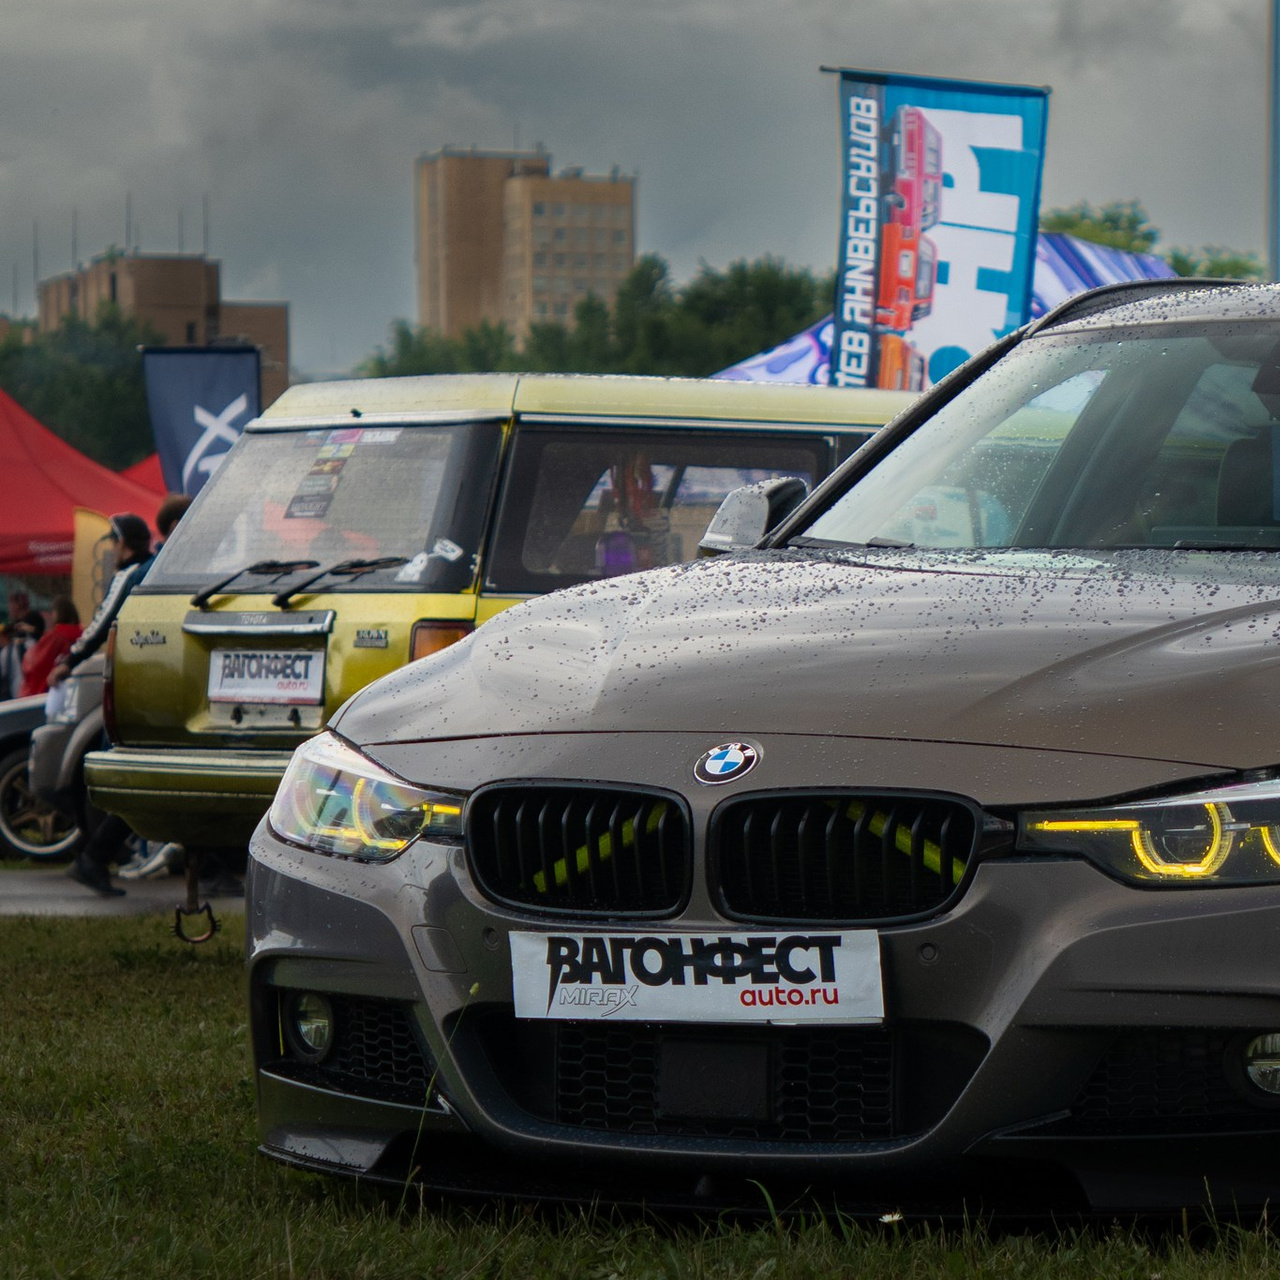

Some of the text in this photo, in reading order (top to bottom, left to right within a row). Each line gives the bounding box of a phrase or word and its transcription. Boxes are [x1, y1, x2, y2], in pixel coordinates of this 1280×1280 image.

[240, 614, 267, 625] TOYOTA
[219, 652, 313, 690] ВАГОНФЕСТ
[276, 679, 309, 691] auto.ru
[545, 934, 842, 1017] ВАГОНФЕСТ
[558, 984, 640, 1018] MIRAX
[739, 985, 840, 1007] auto.ru
